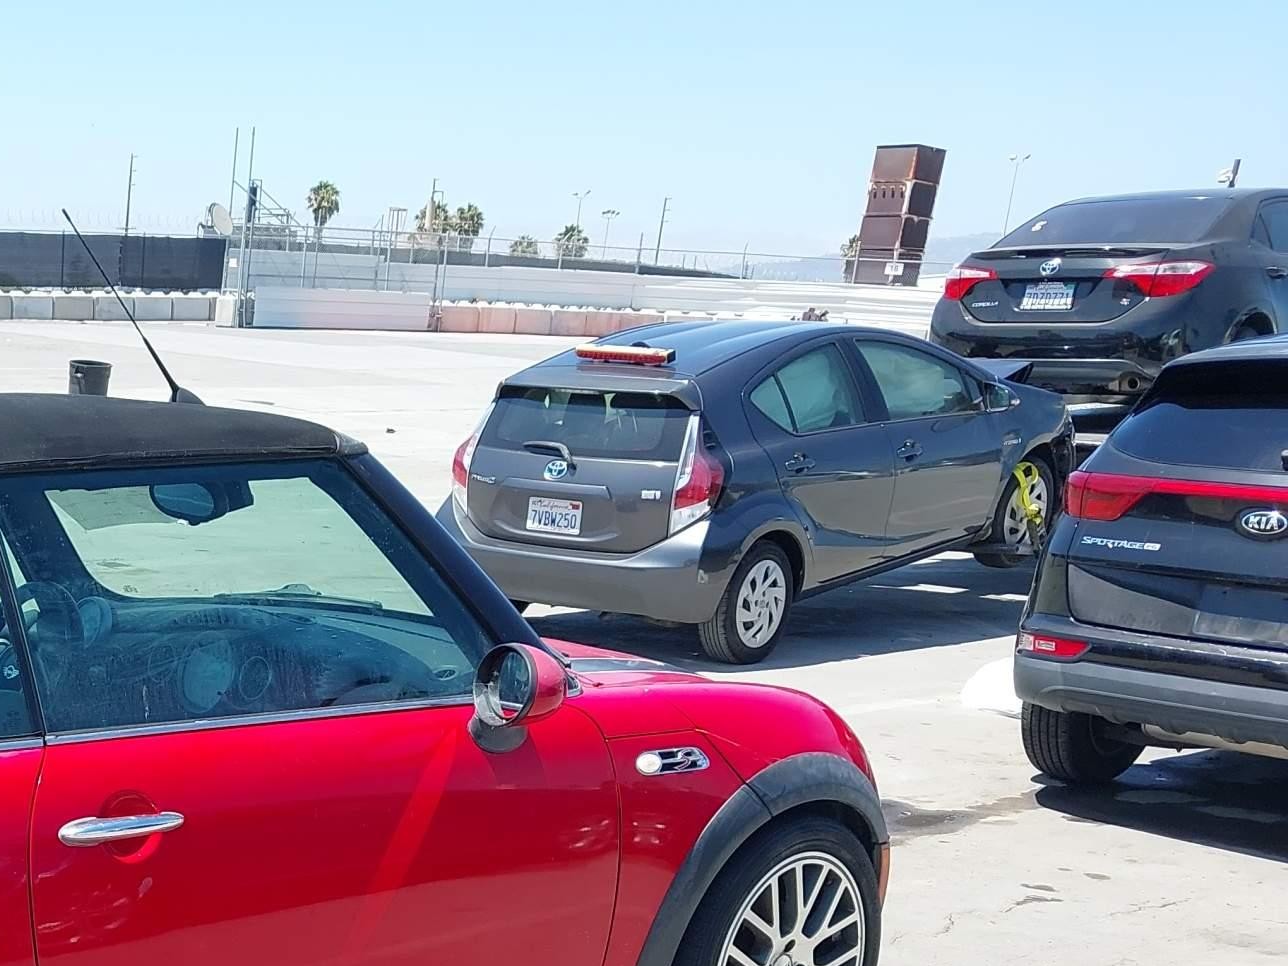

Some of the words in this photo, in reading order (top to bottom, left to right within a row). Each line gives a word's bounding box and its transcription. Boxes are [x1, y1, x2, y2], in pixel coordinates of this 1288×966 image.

[531, 509, 577, 530] 7VBW250
[1248, 514, 1279, 530] KIA
[1081, 535, 1144, 549] SPORTAGE
